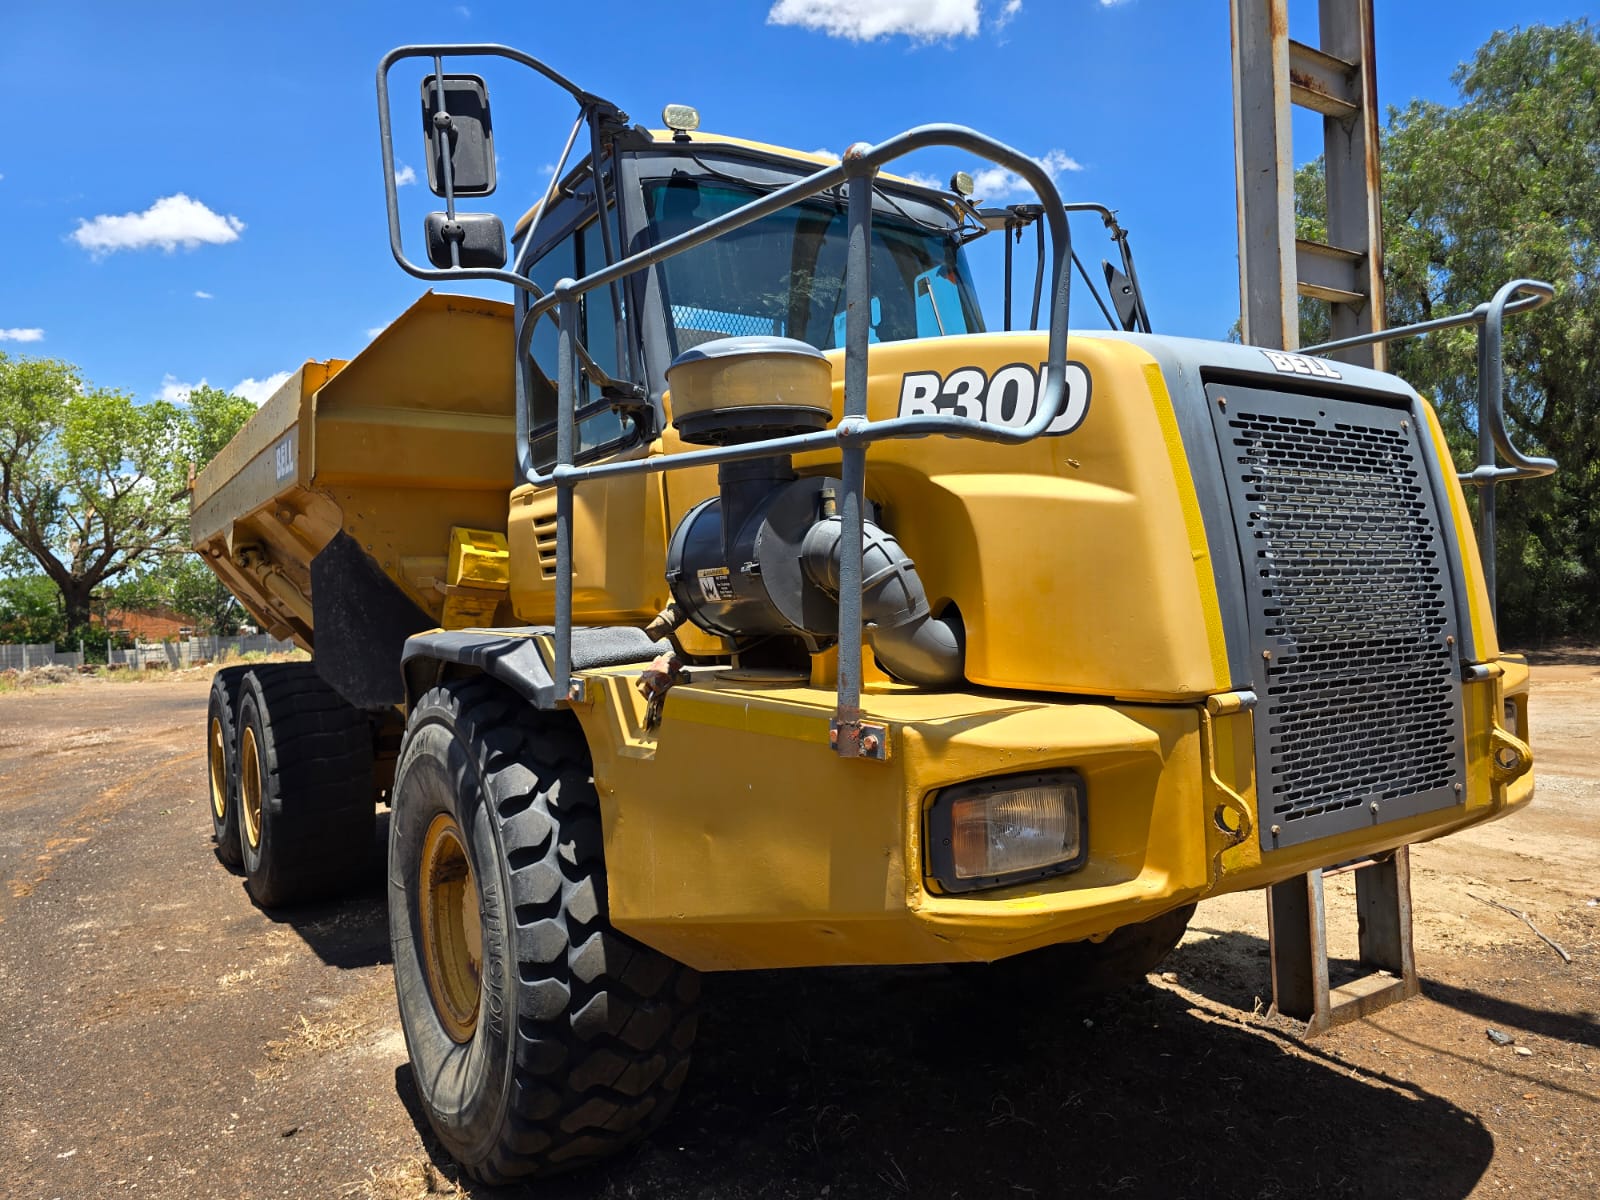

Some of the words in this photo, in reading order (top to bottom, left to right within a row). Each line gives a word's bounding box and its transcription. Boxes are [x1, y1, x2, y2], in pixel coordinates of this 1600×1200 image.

[1261, 351, 1342, 379] BELL
[898, 361, 1092, 438] B30D
[276, 439, 294, 481] BELL
